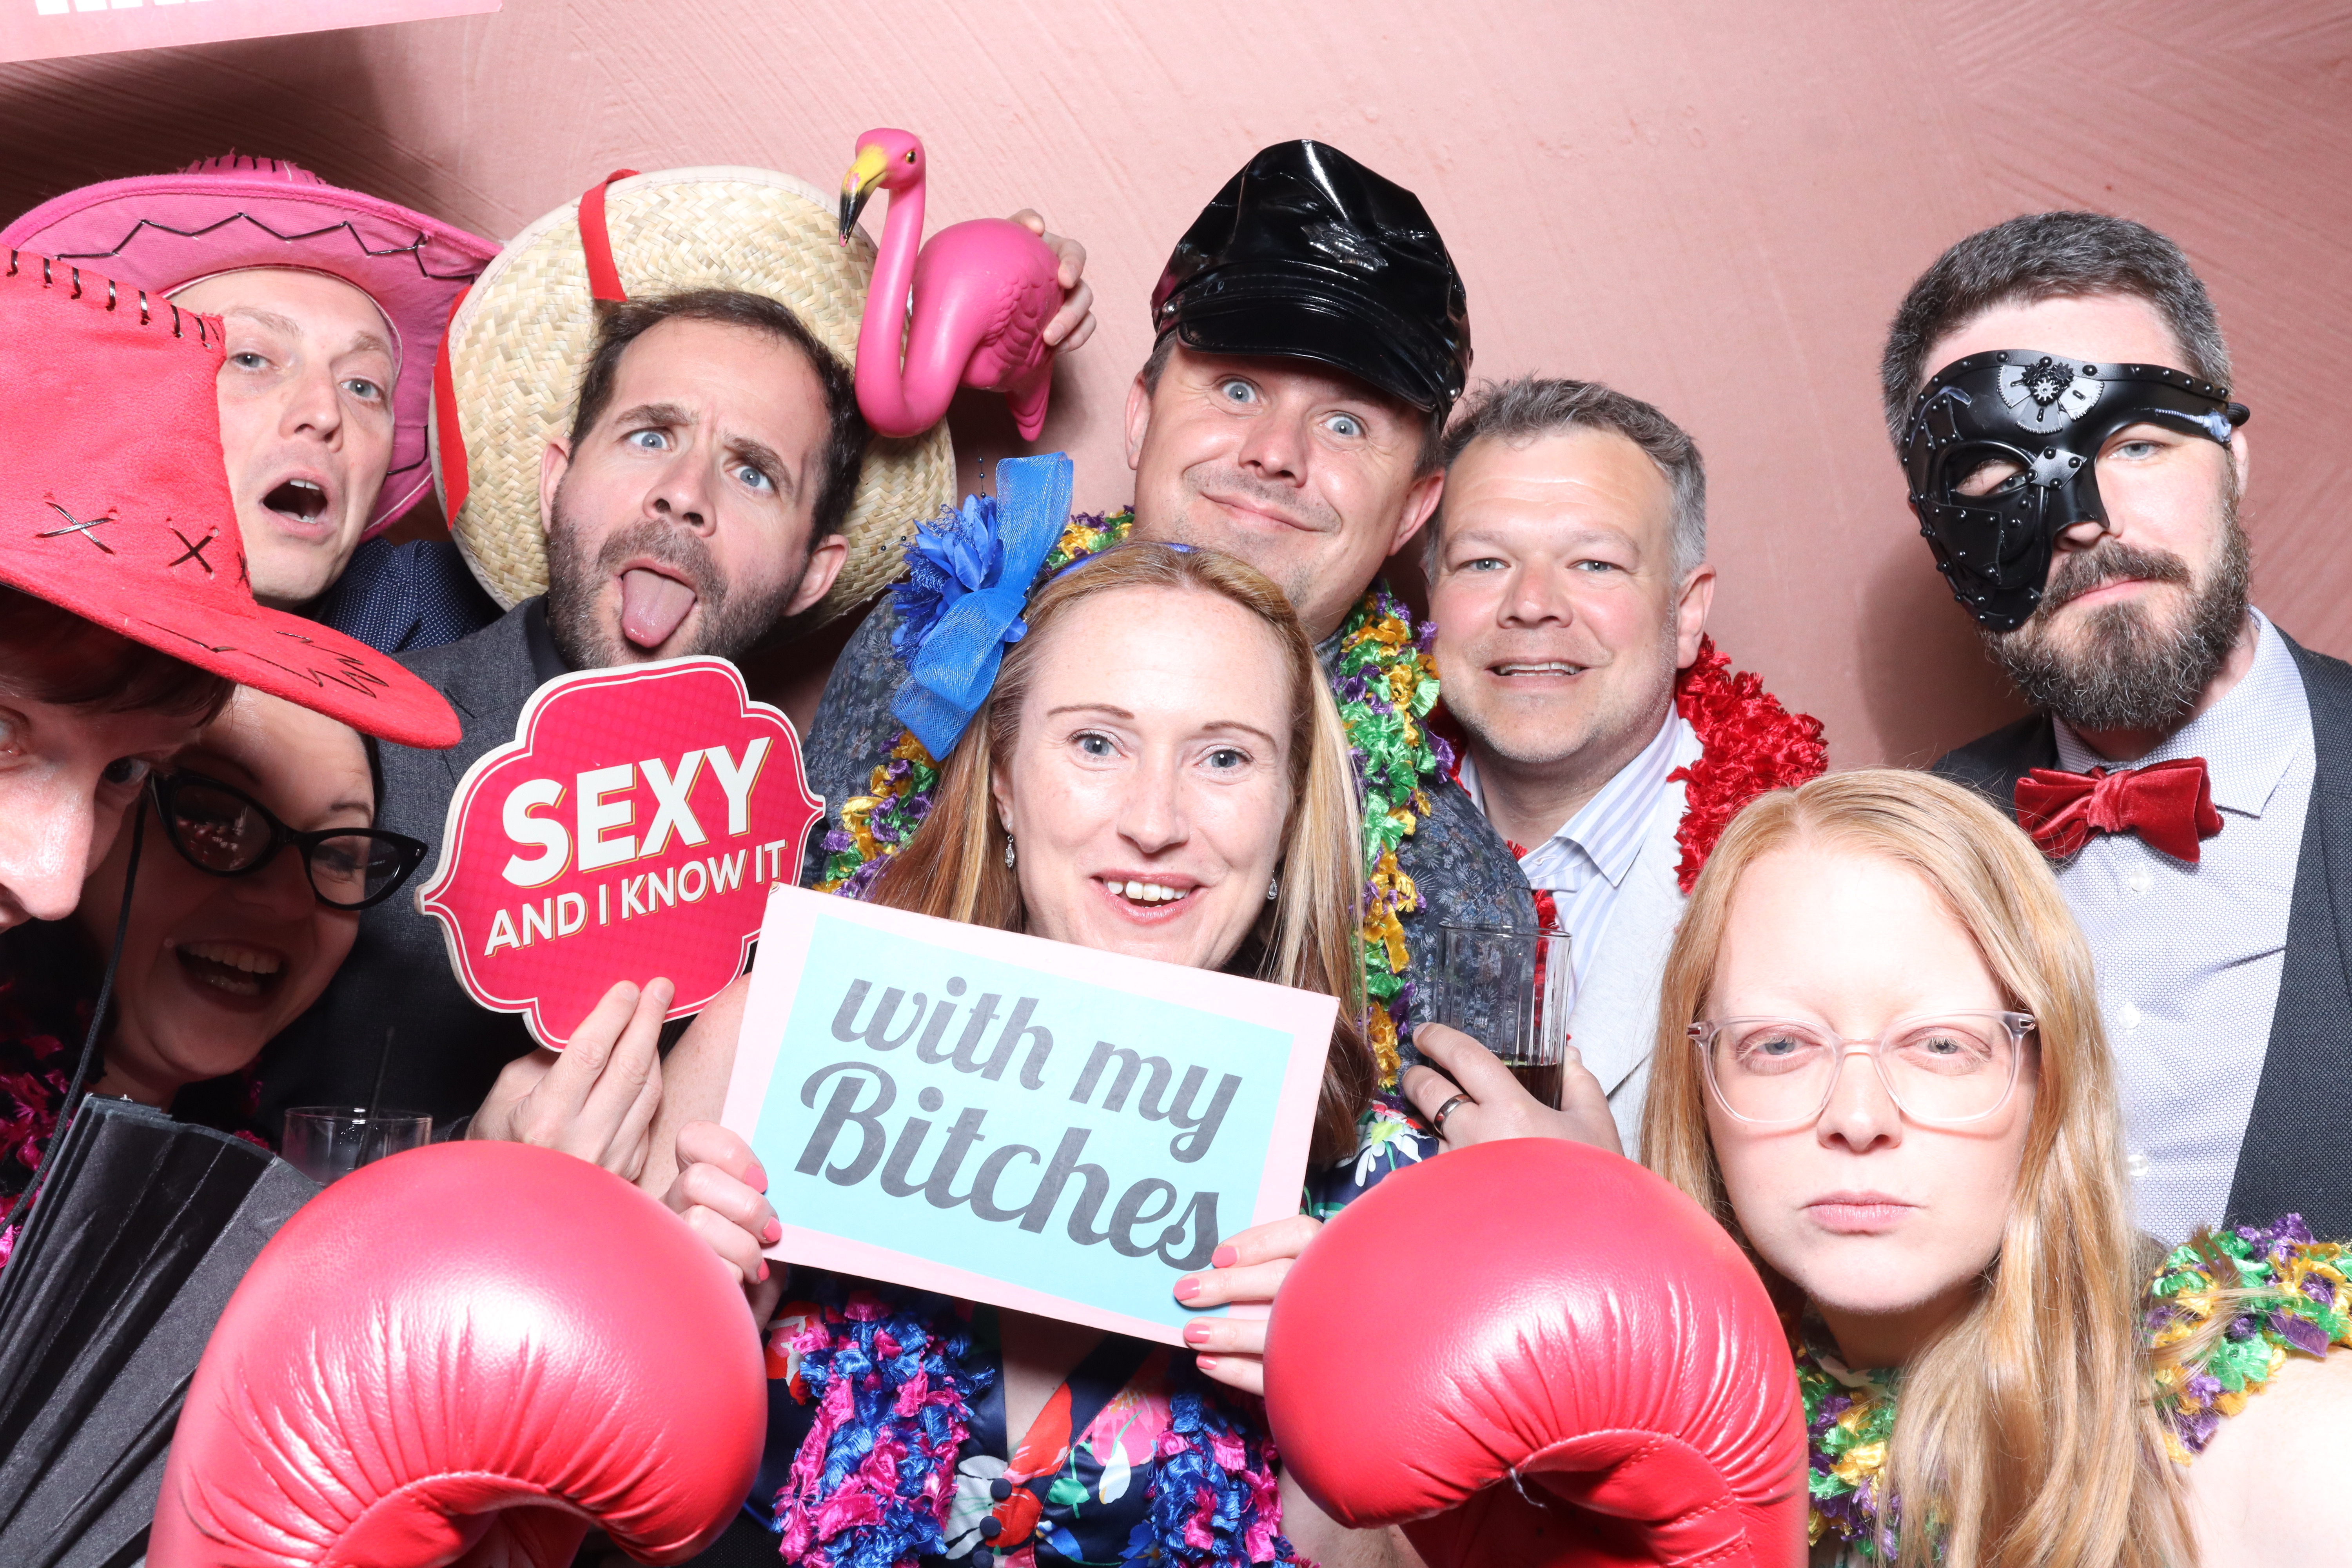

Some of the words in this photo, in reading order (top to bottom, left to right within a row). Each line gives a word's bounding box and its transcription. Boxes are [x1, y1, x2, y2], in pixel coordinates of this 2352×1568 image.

[502, 737, 773, 887] SEXY
[484, 893, 587, 957] AND
[599, 884, 609, 926] I
[621, 849, 748, 920] KNOW
[756, 839, 787, 884] IT
[831, 976, 1054, 1091] with
[1069, 1040, 1243, 1163] my
[794, 1061, 1220, 1271] Bitches
